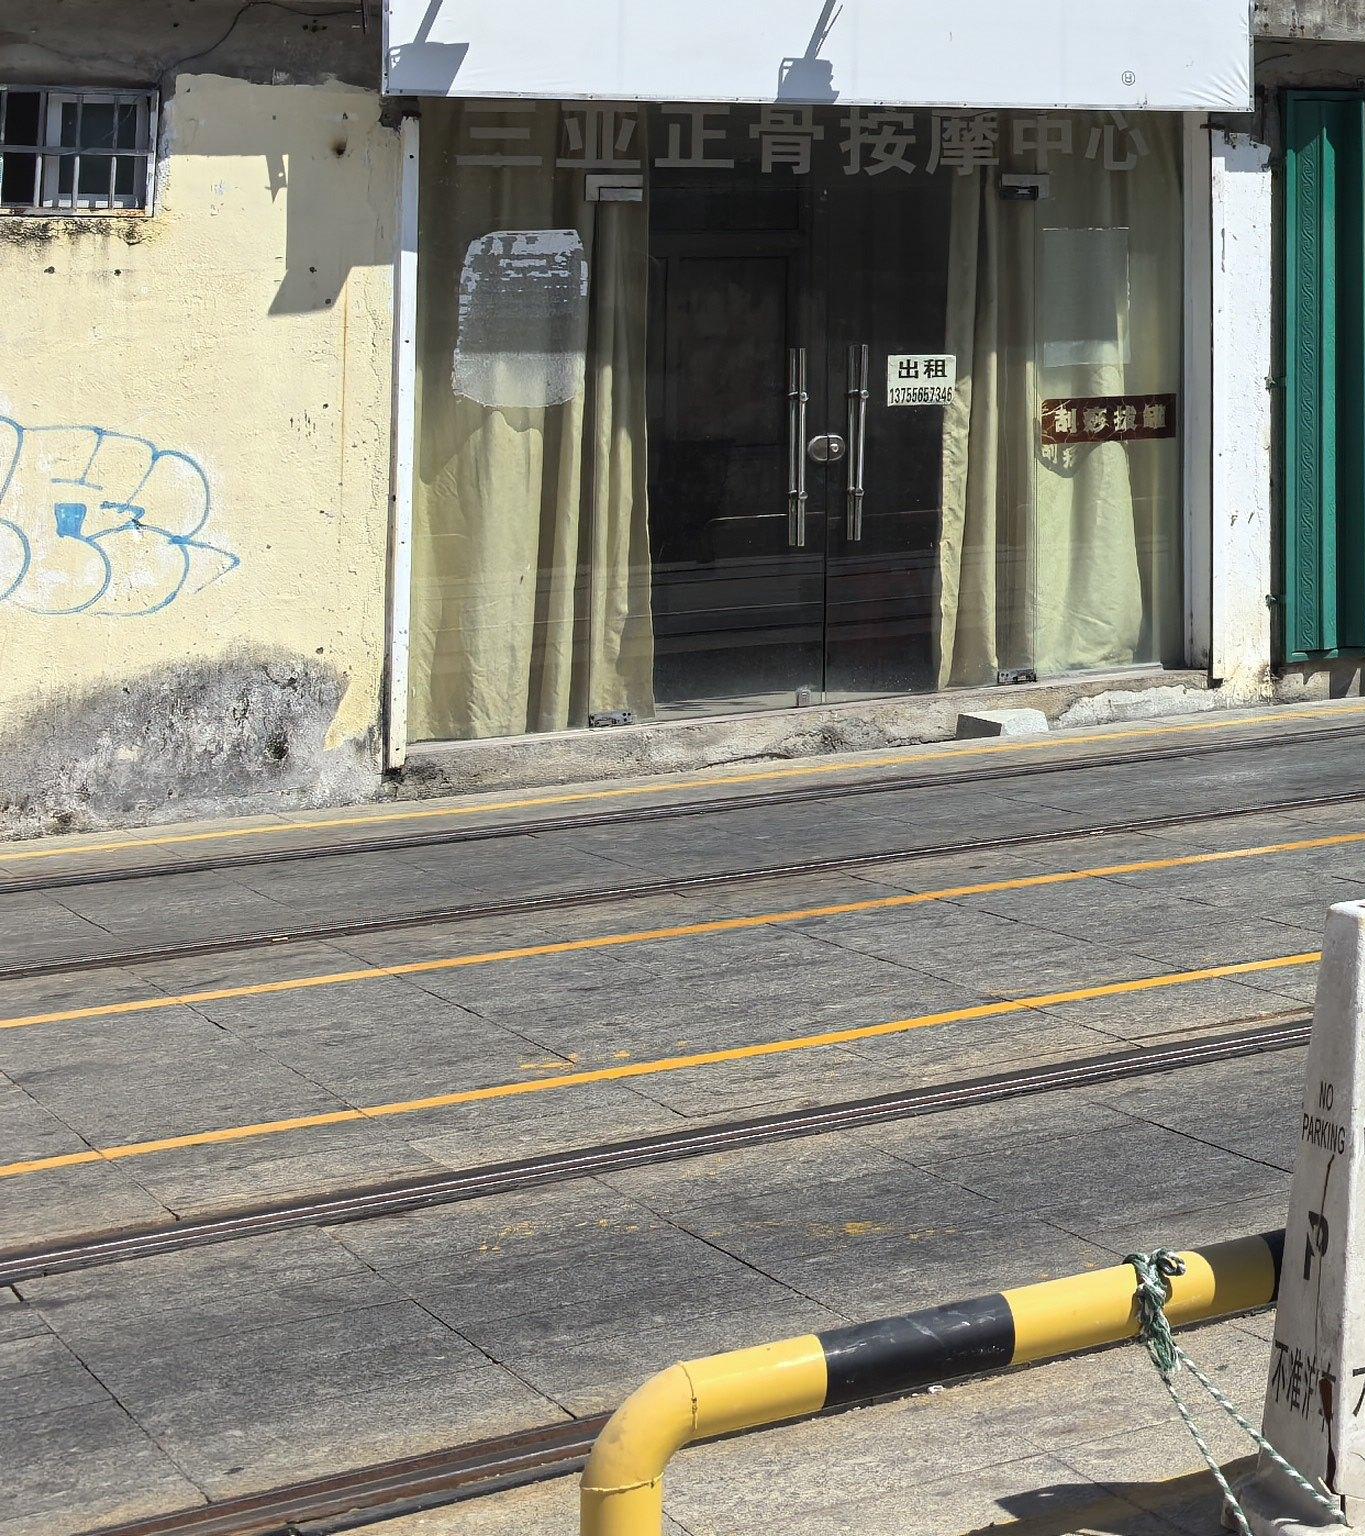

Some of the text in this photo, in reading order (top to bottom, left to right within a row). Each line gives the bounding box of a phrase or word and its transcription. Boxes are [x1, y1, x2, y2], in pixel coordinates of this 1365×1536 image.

[899, 359, 947, 378] 出租
[890, 387, 953, 403] 13755657346
[1319, 1080, 1334, 1112] NO
[1302, 1113, 1346, 1155] PARKING
